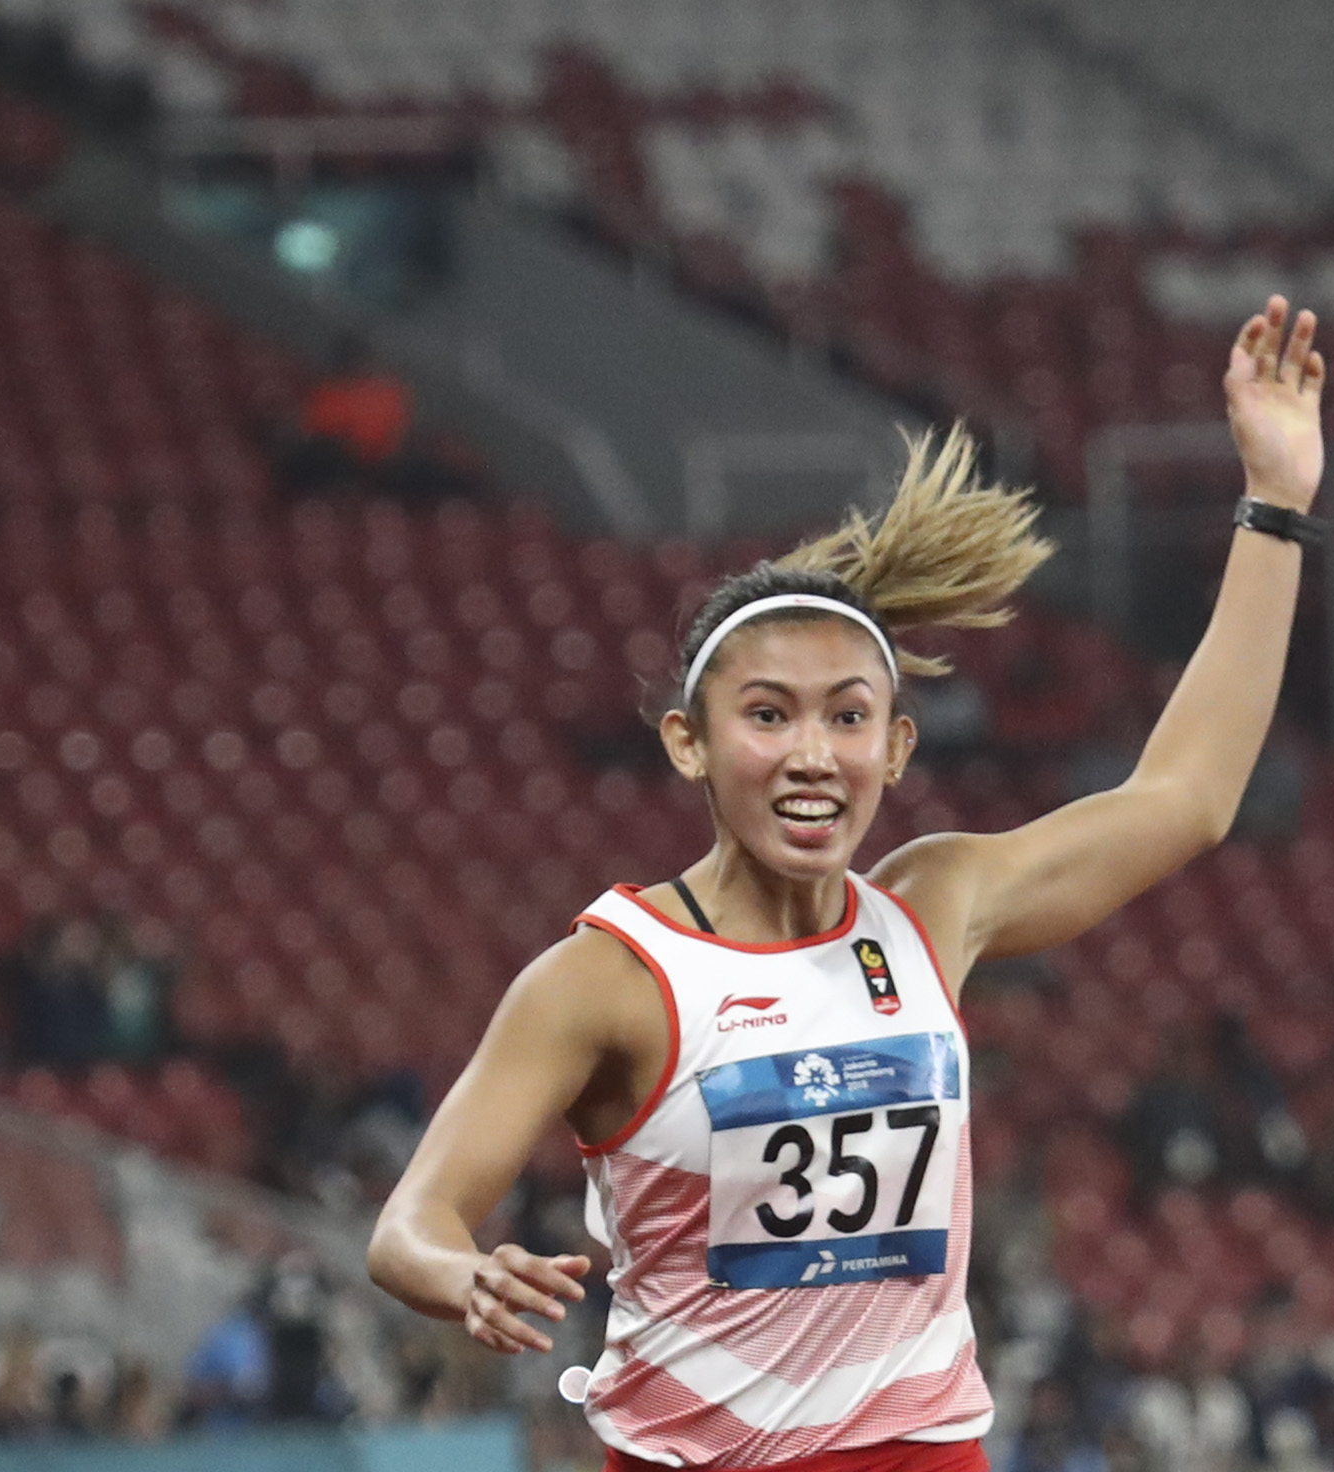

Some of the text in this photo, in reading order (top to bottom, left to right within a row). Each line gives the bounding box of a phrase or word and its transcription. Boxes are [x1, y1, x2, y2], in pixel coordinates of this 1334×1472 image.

[717, 1013, 788, 1033] LI-NING
[754, 1105, 940, 1239] 357
[841, 1254, 908, 1272] PERTAMINA
